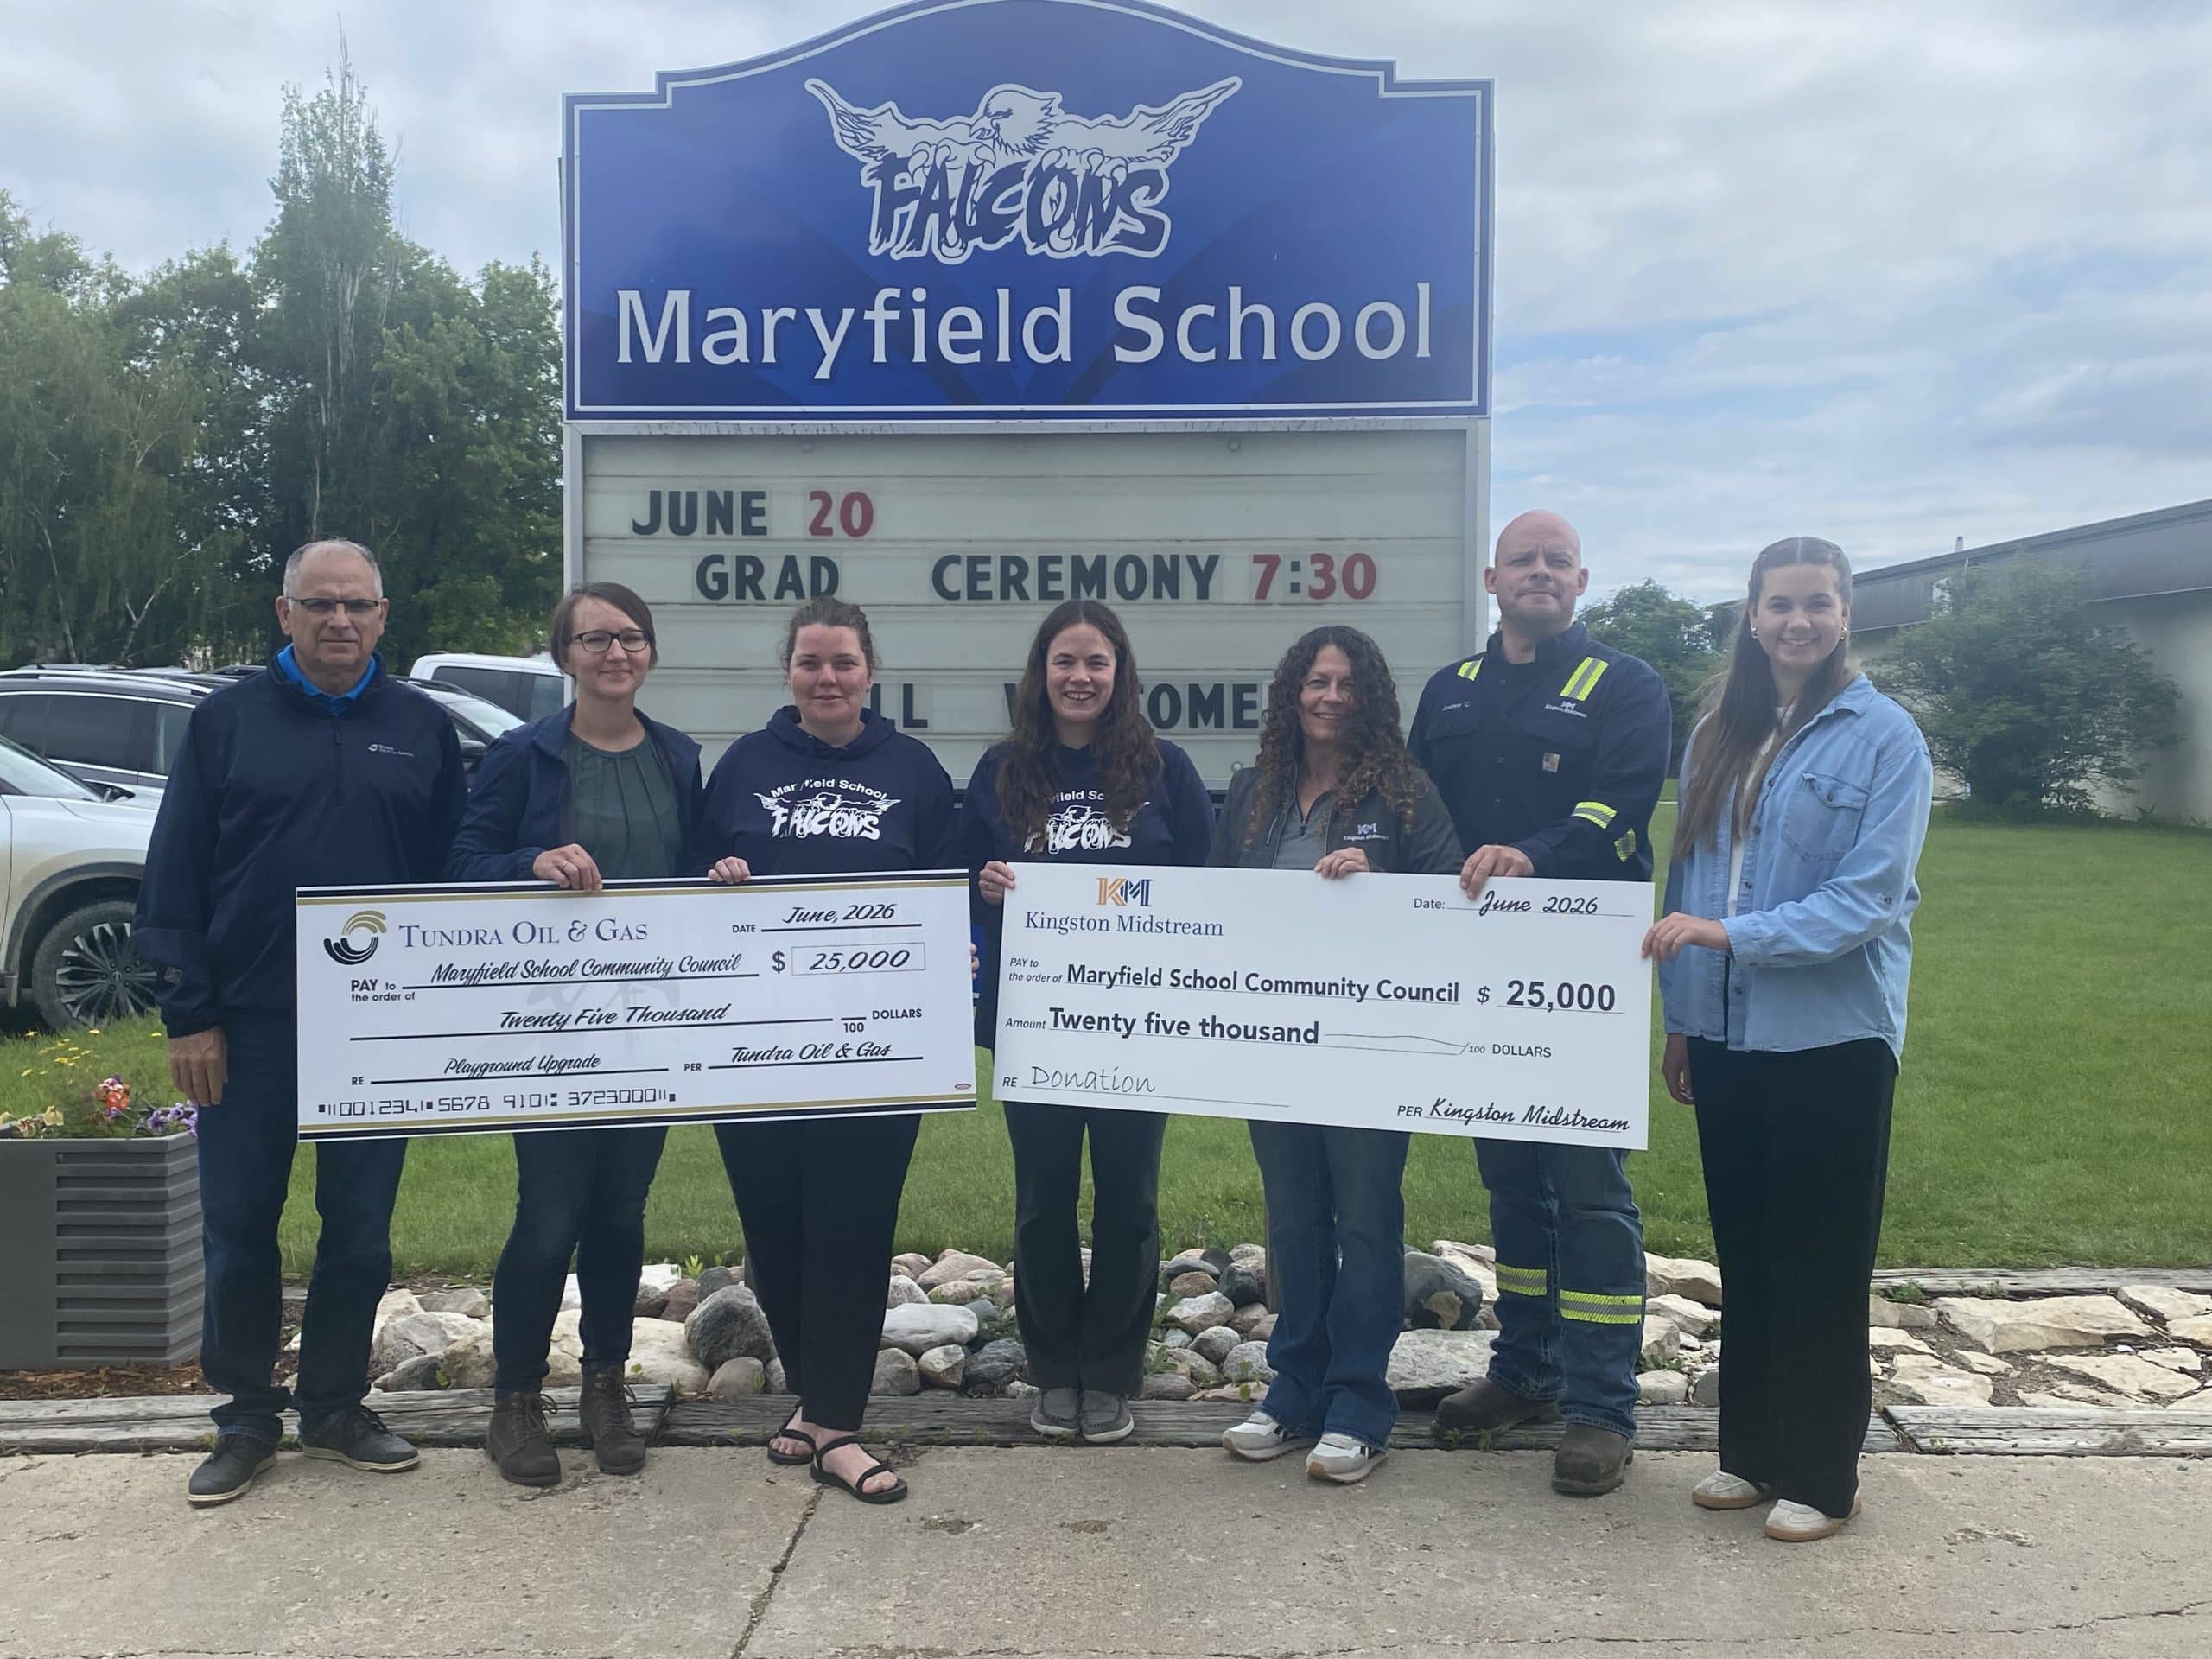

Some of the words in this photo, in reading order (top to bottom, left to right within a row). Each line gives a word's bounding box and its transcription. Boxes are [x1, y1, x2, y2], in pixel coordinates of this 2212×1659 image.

[866, 156, 1171, 263] FALCONS
[616, 287, 1071, 380] Maryfield
[1113, 283, 1431, 365] School
[632, 490, 767, 536] JUNE
[808, 490, 874, 537] 20
[696, 554, 839, 601] GRAD
[931, 554, 1219, 601] CEREMONY
[1253, 552, 1376, 601] 7:30
[870, 679, 928, 728] LL
[838, 779, 888, 800] School
[772, 805, 881, 840] FALCONS
[1096, 877, 1153, 907] KM
[1414, 898, 1446, 910] Date:
[1478, 890, 1531, 917] June
[1542, 896, 1599, 914] 2026
[398, 924, 505, 948] TUNDRA
[567, 919, 588, 943] &
[595, 916, 648, 941] GAS
[732, 924, 757, 934] DATE
[781, 906, 839, 925] June,
[842, 903, 897, 921] 2026
[1024, 911, 1110, 936] Kingston
[1116, 914, 1224, 937] Midstream
[350, 979, 379, 992] PAY
[385, 982, 397, 991] to
[431, 961, 520, 987] Maryfield
[520, 958, 581, 979] School
[581, 955, 675, 981] Community
[677, 952, 743, 974] Council
[772, 950, 786, 975] $
[808, 950, 912, 973] 25,000
[1008, 972, 1025, 982] the
[1026, 974, 1052, 983] order
[1052, 974, 1063, 983] of
[1009, 957, 1028, 968] PAY
[1029, 959, 1039, 969] to
[351, 994, 369, 1003] the
[372, 993, 402, 1002] order
[404, 992, 416, 1001] of
[1067, 963, 1163, 990] Maryfield
[1169, 969, 1238, 991] School
[1244, 973, 1370, 1003] Community
[1376, 979, 1459, 1003] Council
[1477, 985, 1491, 1005] $
[1506, 979, 1616, 1012] 25,000
[499, 1009, 573, 1031] Twenty
[573, 1007, 620, 1027] Five
[625, 1002, 733, 1025] Thousand
[843, 1022, 865, 1033] 100
[872, 1008, 924, 1020] DOLLARS
[1005, 1017, 1046, 1030] Amount
[1049, 1007, 1137, 1039] Twenty
[1144, 1011, 1191, 1037] five
[1198, 1014, 1319, 1045] thousand
[1491, 1043, 1552, 1058] DOLLARS
[351, 1077, 364, 1086] RE
[443, 1056, 537, 1078] Playground
[537, 1053, 601, 1075] Upgrade
[683, 1063, 702, 1072] PER
[732, 1046, 795, 1064] Tundra
[798, 1042, 835, 1060] Oil
[835, 1042, 855, 1058] &
[856, 1040, 893, 1058] Gas
[1002, 1077, 1018, 1088] RE
[1031, 1065, 1156, 1094] Donation
[438, 1096, 490, 1112] 5678
[1397, 1104, 1424, 1117] PER
[1430, 1097, 1516, 1126] Kingston
[1520, 1104, 1630, 1131] Midstream
